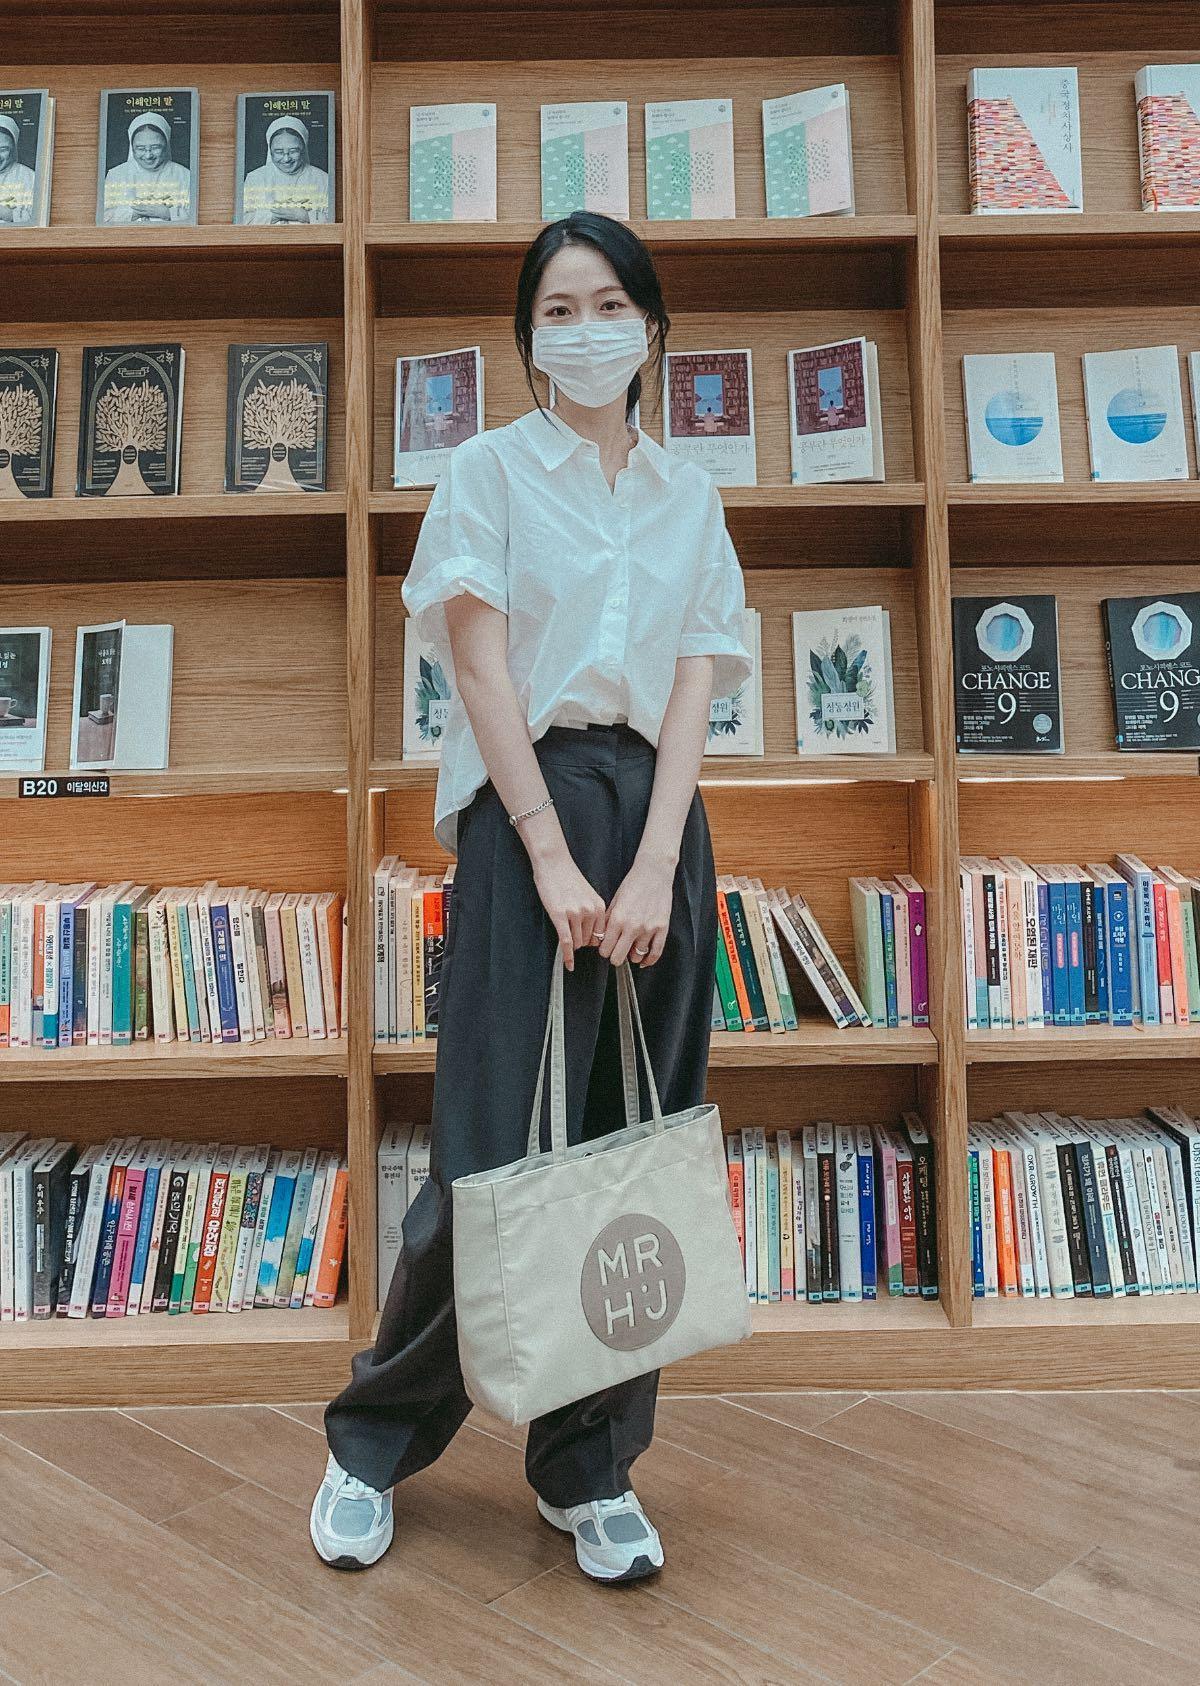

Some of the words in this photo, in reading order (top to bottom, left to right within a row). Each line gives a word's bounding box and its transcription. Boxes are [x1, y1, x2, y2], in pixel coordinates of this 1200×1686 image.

[15, 98, 24, 109] 말
[126, 96, 161, 107] 이해인의
[164, 96, 173, 106] 말
[263, 100, 299, 111] 이해인의
[301, 100, 311, 110] 말
[1060, 79, 1072, 152] 중국정치사상사
[962, 671, 1051, 690] CHANGE
[998, 692, 1017, 725] 9
[1159, 690, 1179, 723] 9
[23, 780, 57, 796] B20
[66, 781, 108, 793] 이달의신간
[62, 917, 71, 936] 부동산
[1025, 917, 1037, 947] 오염된
[1027, 948, 1038, 969] 재판
[1081, 1153, 1091, 1178] 정치가
[1086, 1188, 1095, 1203] 이래
[1029, 1174, 1039, 1209] GROWTH
[1100, 1178, 1112, 1212] 클라우드
[903, 1206, 912, 1223] 아이
[104, 1235, 114, 1250] 미래
[597, 1232, 663, 1286] MR
